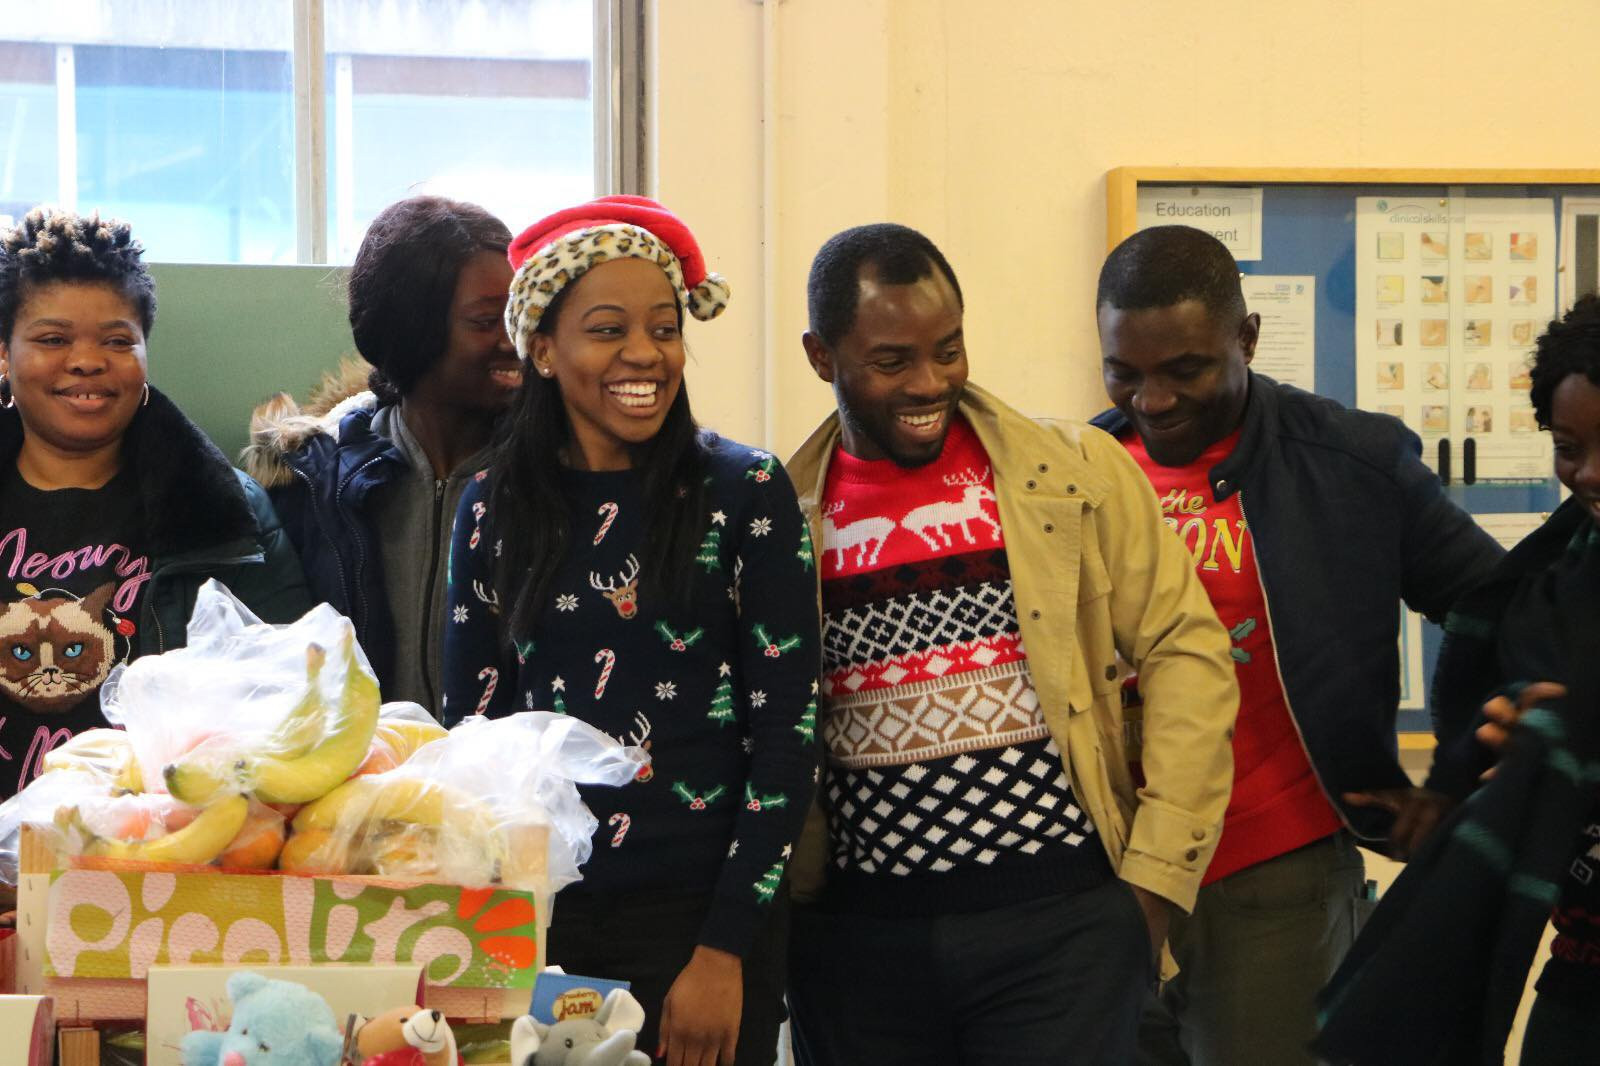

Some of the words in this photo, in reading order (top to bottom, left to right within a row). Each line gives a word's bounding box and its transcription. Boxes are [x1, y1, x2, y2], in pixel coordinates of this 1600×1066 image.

[1155, 202, 1231, 217] Education
[1209, 227, 1238, 241] ent
[1160, 488, 1208, 514] the
[1161, 517, 1248, 573] ON
[558, 998, 598, 1022] jam
